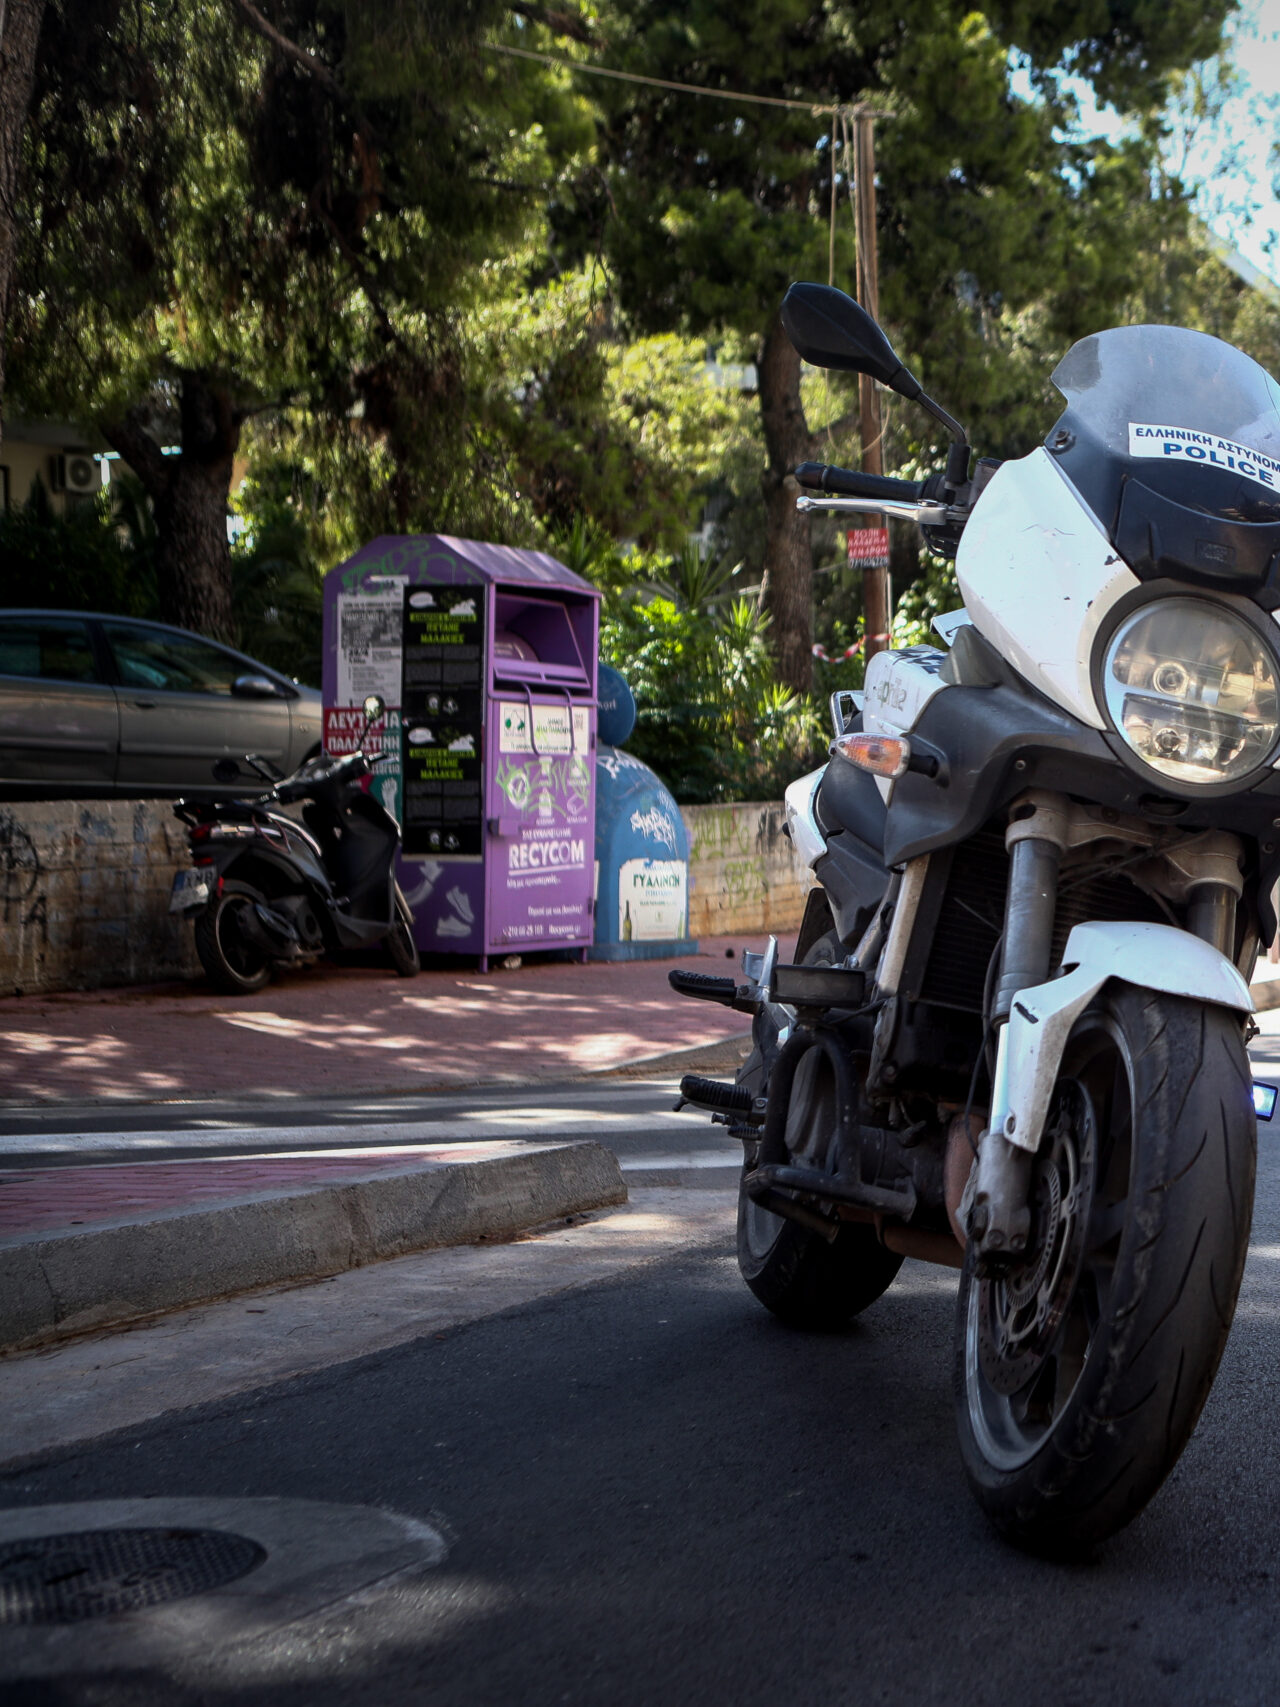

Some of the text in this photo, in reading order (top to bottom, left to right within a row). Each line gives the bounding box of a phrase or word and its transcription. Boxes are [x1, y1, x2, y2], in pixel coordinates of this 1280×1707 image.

[1135, 427, 1213, 446] ΕΛΛΗΝΙΚΗ
[1163, 442, 1275, 486] POLICE
[509, 840, 585, 869] RECYCOM
